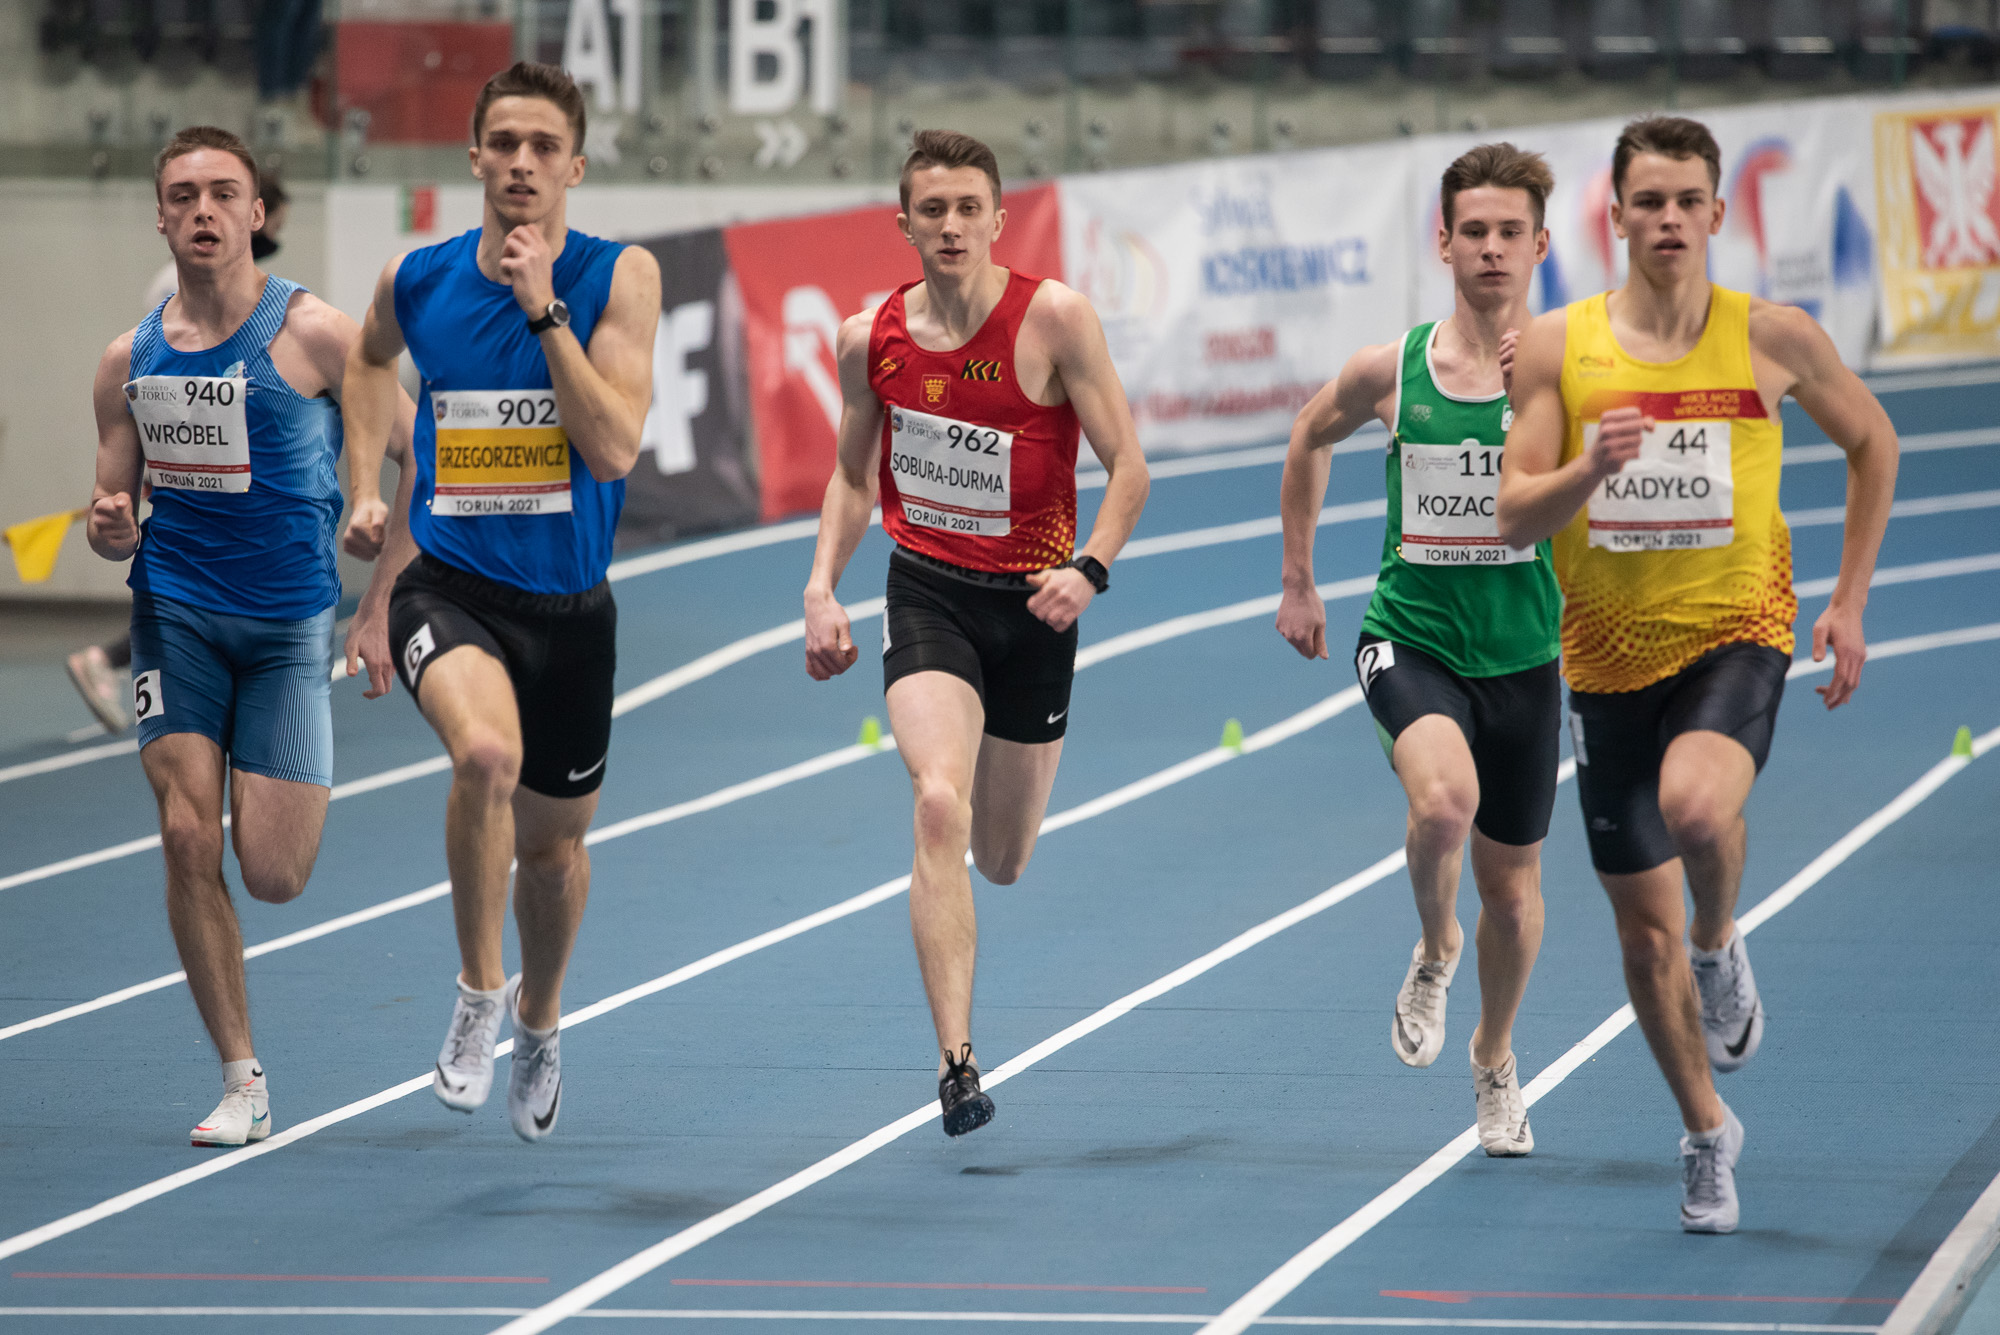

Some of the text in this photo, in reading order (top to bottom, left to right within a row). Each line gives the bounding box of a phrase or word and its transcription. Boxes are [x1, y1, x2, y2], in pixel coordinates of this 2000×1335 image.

[562, 0, 642, 112] A1
[730, 0, 836, 114] B1
[141, 390, 177, 401] TORUŃ
[184, 381, 234, 406] 940
[927, 394, 940, 402] CK
[451, 399, 556, 425] TORUŃ 902
[142, 421, 229, 445] WRÓBEL
[906, 424, 1000, 456] TORUŃ 962
[1668, 428, 1708, 455] 44
[159, 473, 223, 488] TORUŃ 2021
[892, 452, 1005, 493] SOBURA-DURMA
[1605, 477, 1711, 499] KADYŁO
[456, 495, 541, 512] TORUŃ 2021
[907, 508, 980, 531] TORUŃ 2021
[1667, 532, 1702, 546] 2021
[1425, 547, 1506, 561] TORUŃ 2021
[408, 638, 423, 671] 6
[1362, 646, 1383, 683] 2
[136, 675, 152, 718] 5
